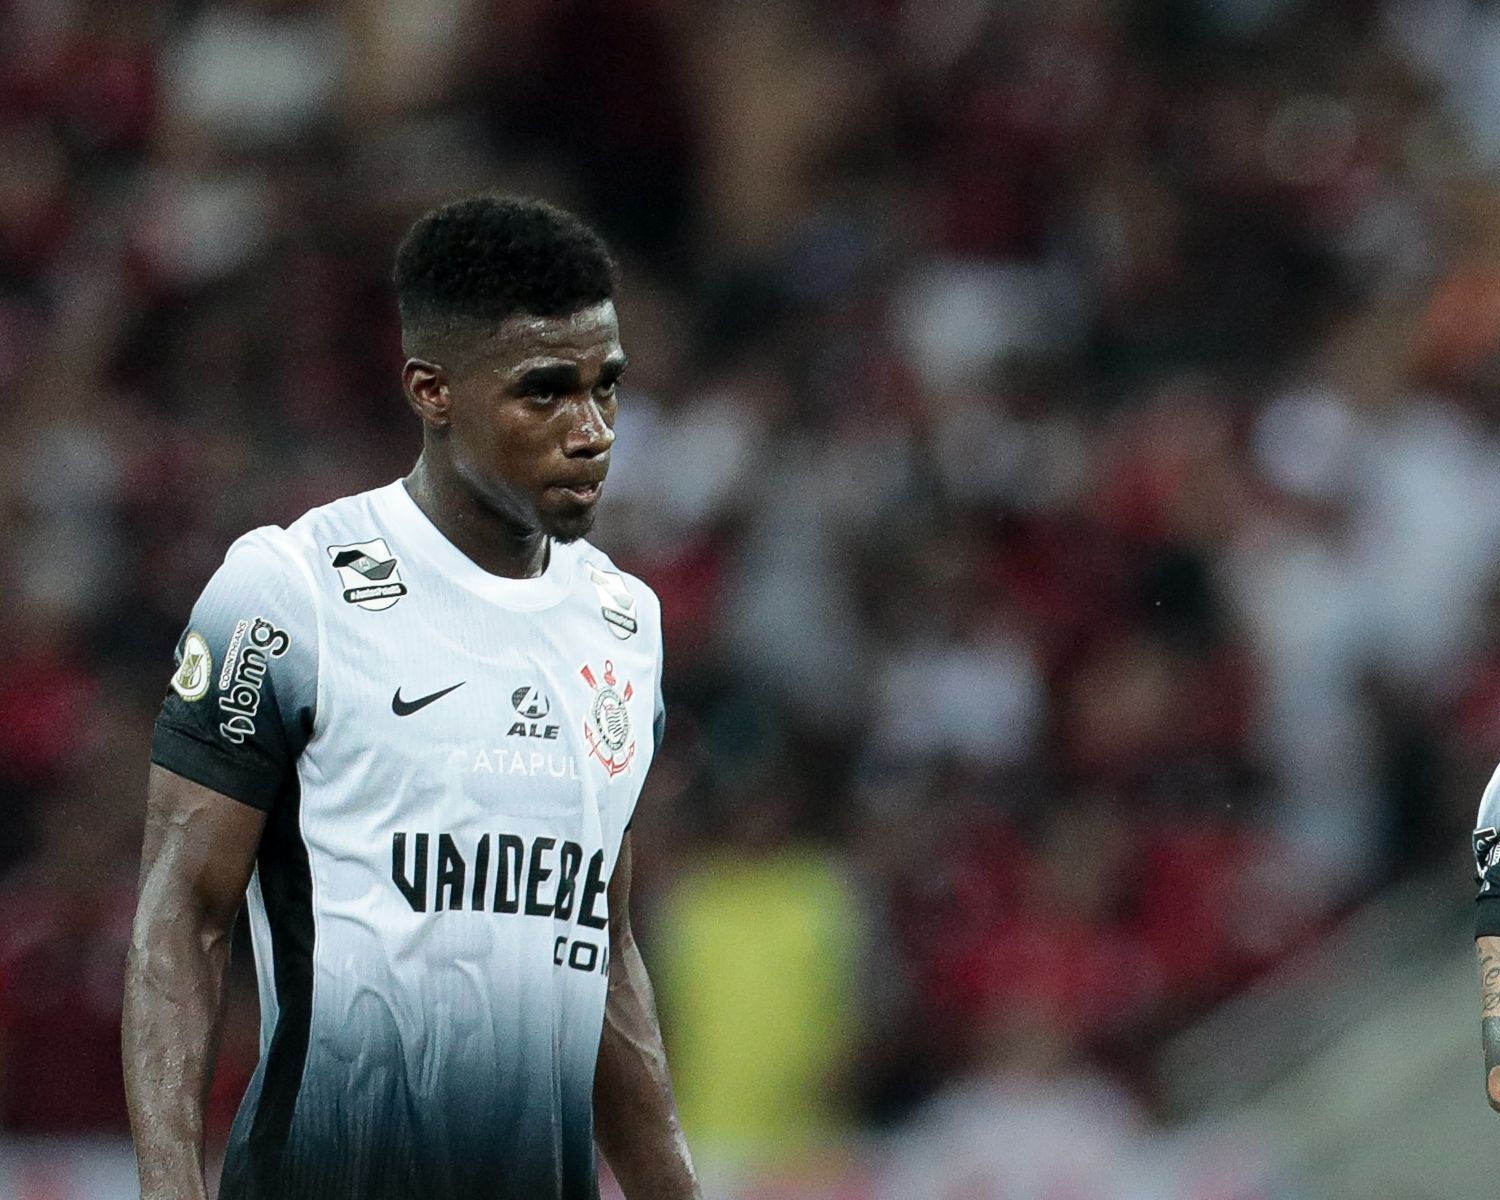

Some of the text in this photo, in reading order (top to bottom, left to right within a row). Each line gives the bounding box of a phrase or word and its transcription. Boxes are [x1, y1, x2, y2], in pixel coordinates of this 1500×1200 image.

[219, 620, 249, 690] CORINTHIANS
[219, 616, 291, 717] bmg
[506, 722, 560, 740] ALE
[554, 935, 609, 977] CO
